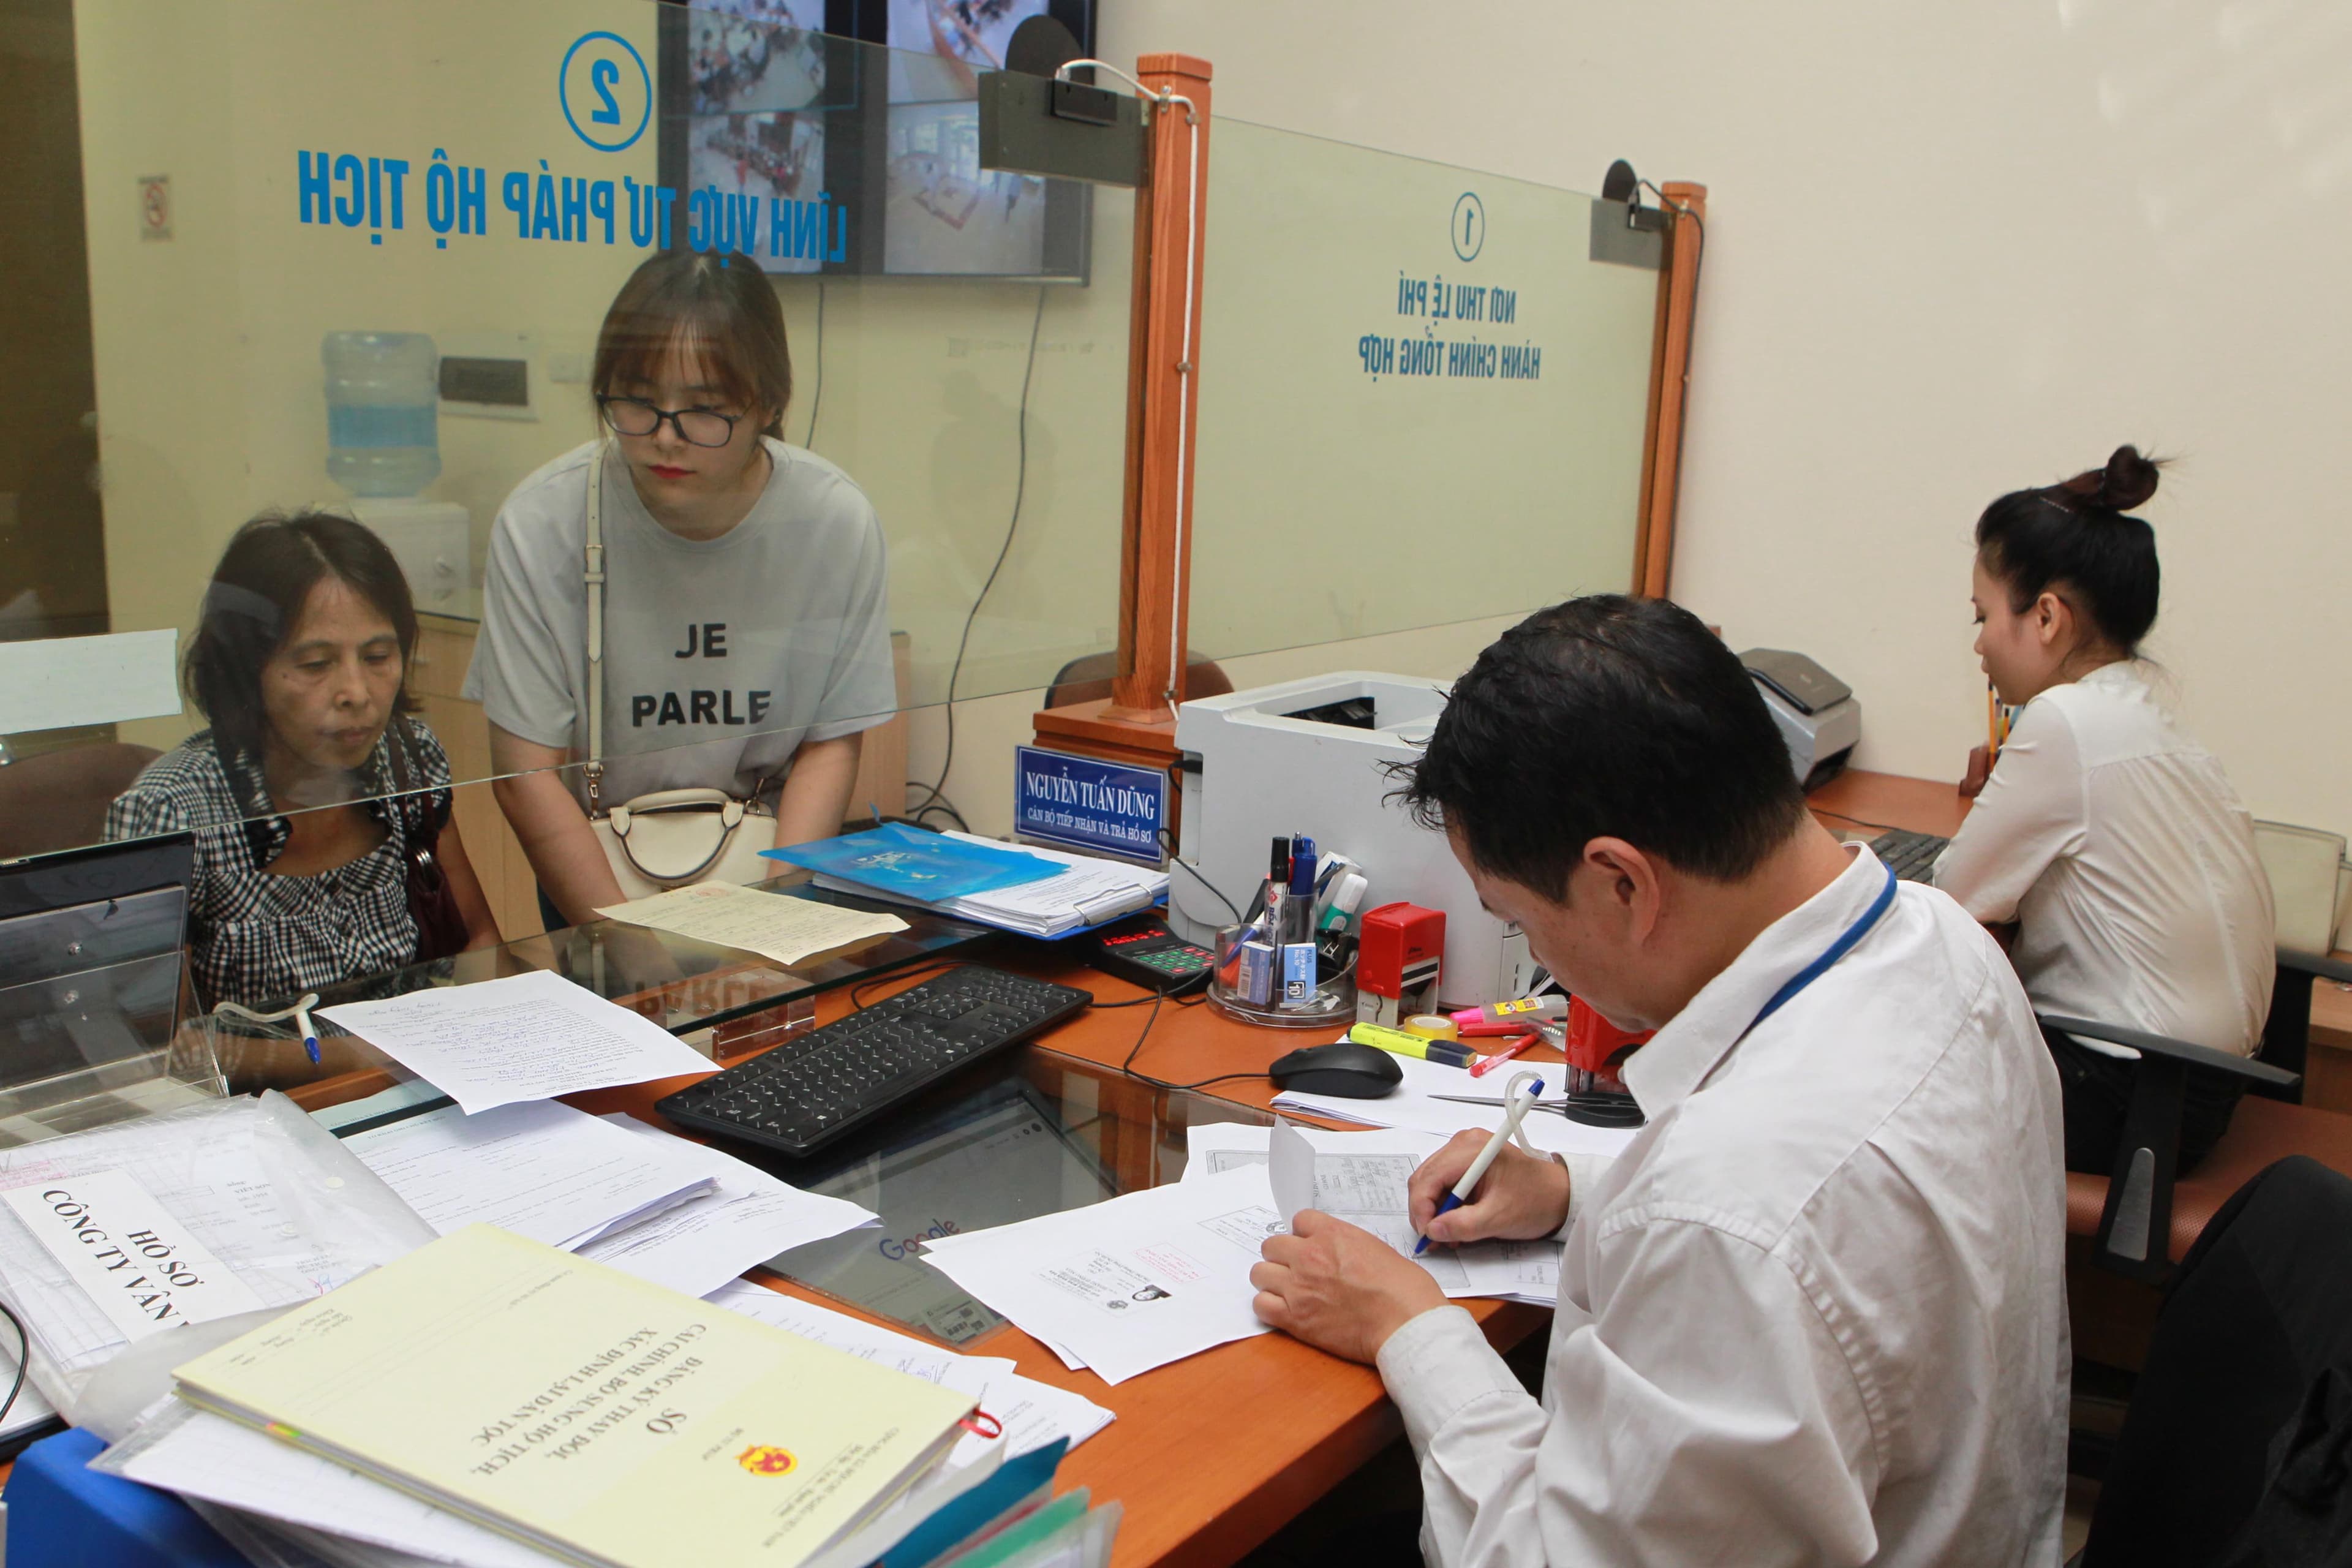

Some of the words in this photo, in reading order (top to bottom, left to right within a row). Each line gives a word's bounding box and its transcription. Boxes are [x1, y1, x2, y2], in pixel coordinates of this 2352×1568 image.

[675, 624, 727, 658] JE
[632, 690, 771, 727] PARLE
[1027, 766, 1078, 805] NGUYỄN
[1080, 775, 1115, 813] TUẤN
[1117, 786, 1155, 820] DŨNG
[1028, 805, 1042, 821] CÁN
[1045, 808, 1055, 827] BỘ
[1056, 810, 1073, 827] TIẾP
[1074, 816, 1097, 834] NHẬN
[1098, 820, 1109, 835] VÀ
[1110, 821, 1126, 839] TRẢ
[1128, 825, 1139, 841] HỒ
[1140, 829, 1152, 843] SƠ
[1289, 984, 1300, 995] 10
[43, 1189, 110, 1245] CÔNG
[94, 1246, 138, 1272] TY
[124, 1276, 180, 1321] VÂN
[158, 1261, 205, 1287] SƠ
[587, 1405, 636, 1436] THAY
